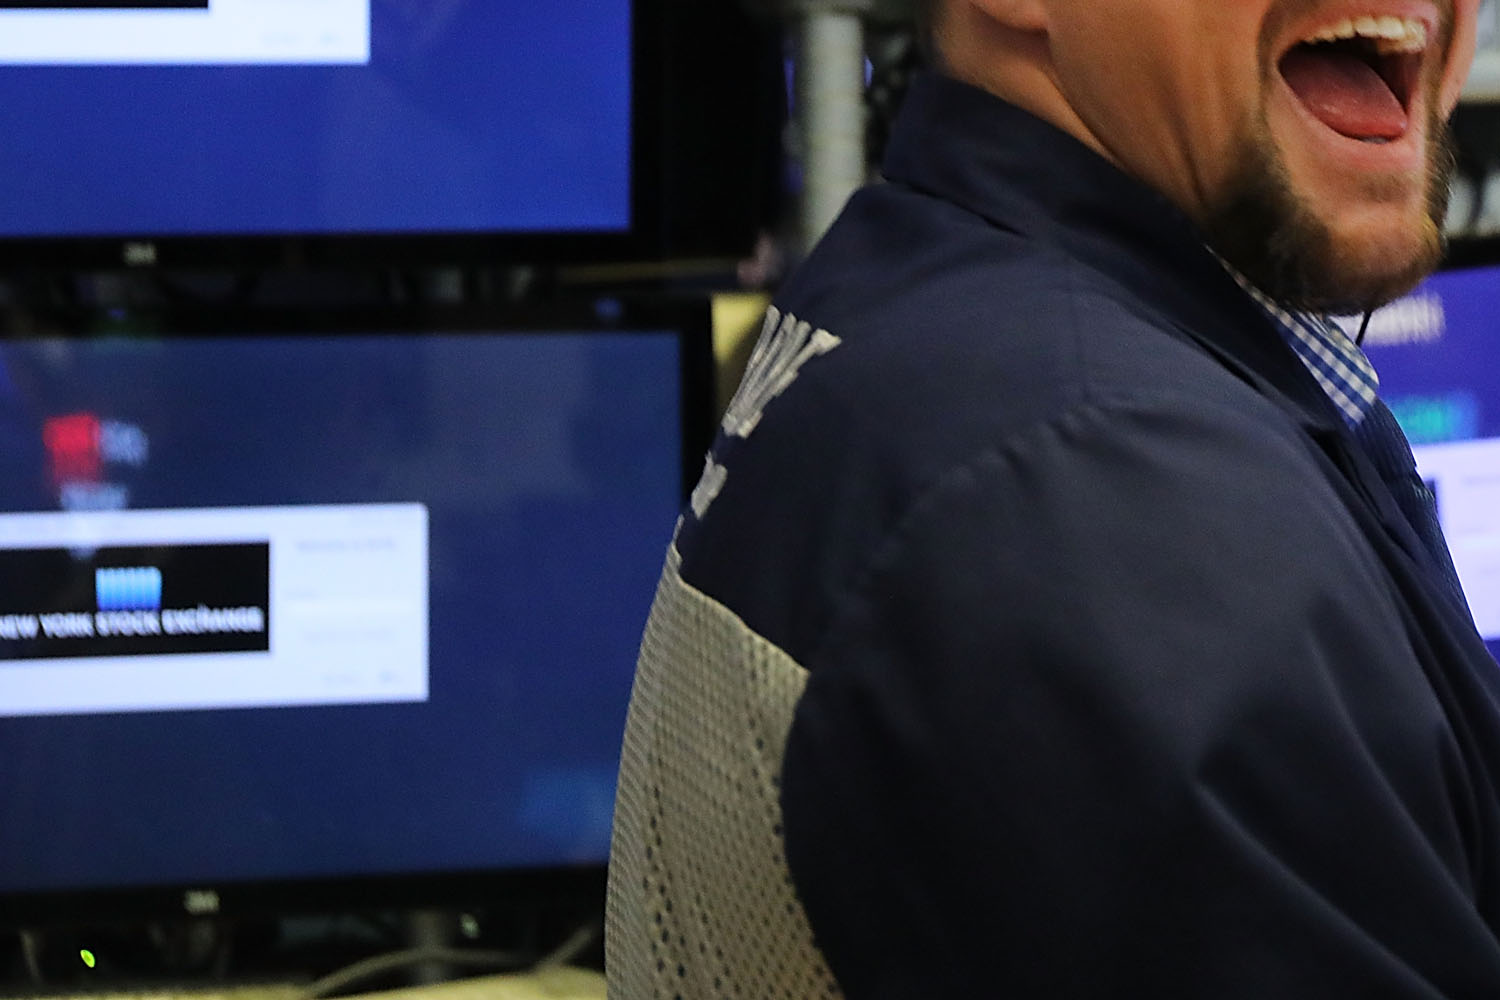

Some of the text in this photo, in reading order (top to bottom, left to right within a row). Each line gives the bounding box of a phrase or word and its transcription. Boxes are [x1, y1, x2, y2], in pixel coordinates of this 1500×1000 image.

[41, 611, 95, 639] YORK
[96, 610, 161, 637] STOCK
[162, 605, 264, 635] EXCHANGE
